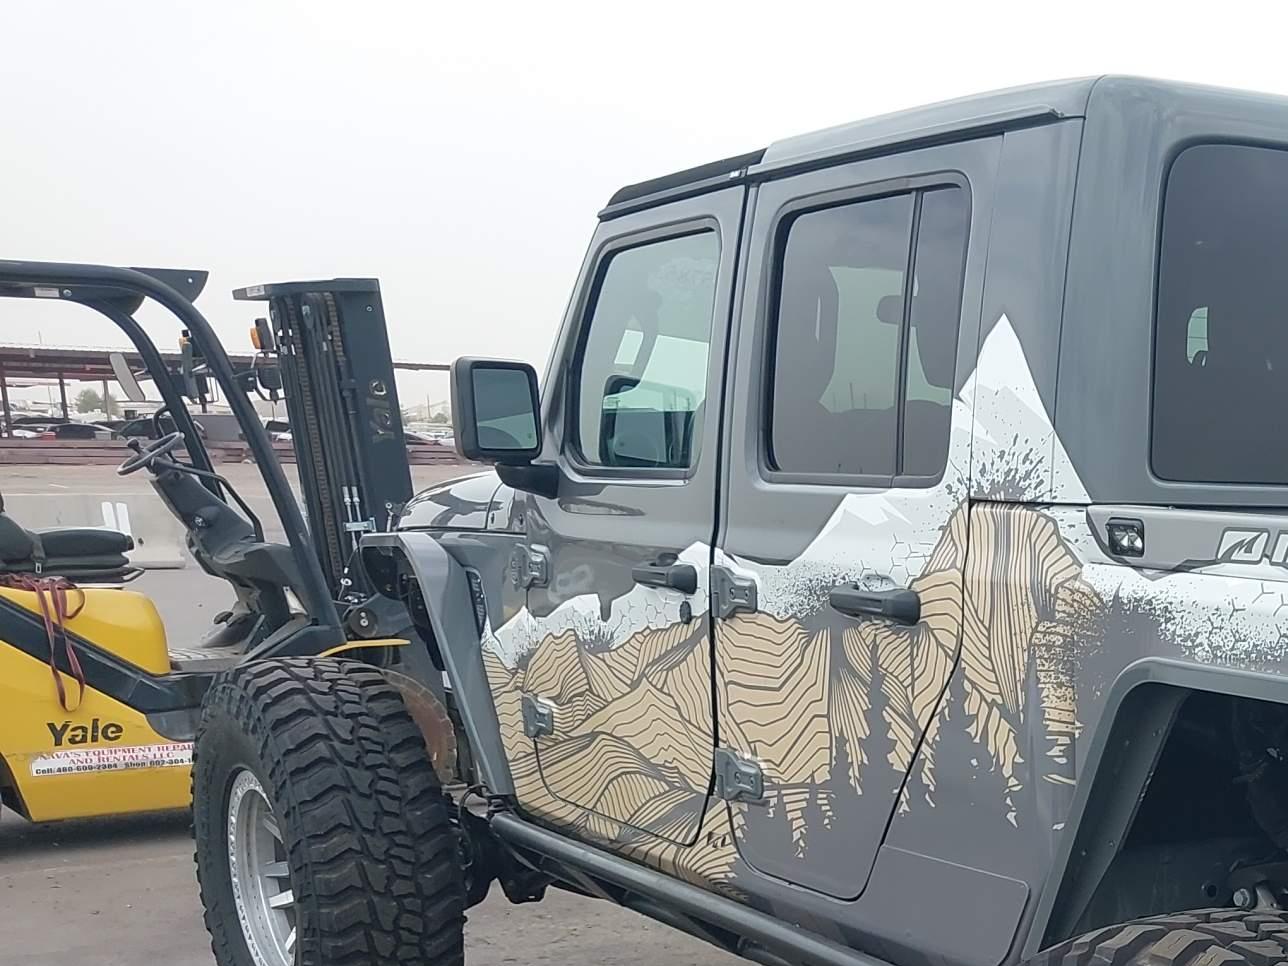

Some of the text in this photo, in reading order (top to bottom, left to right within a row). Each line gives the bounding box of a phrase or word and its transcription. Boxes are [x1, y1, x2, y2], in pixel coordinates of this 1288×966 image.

[47, 718, 123, 747] Yale
[85, 746, 152, 758] EQUIPMENT
[157, 743, 194, 753] REPAI
[69, 757, 94, 765] AND
